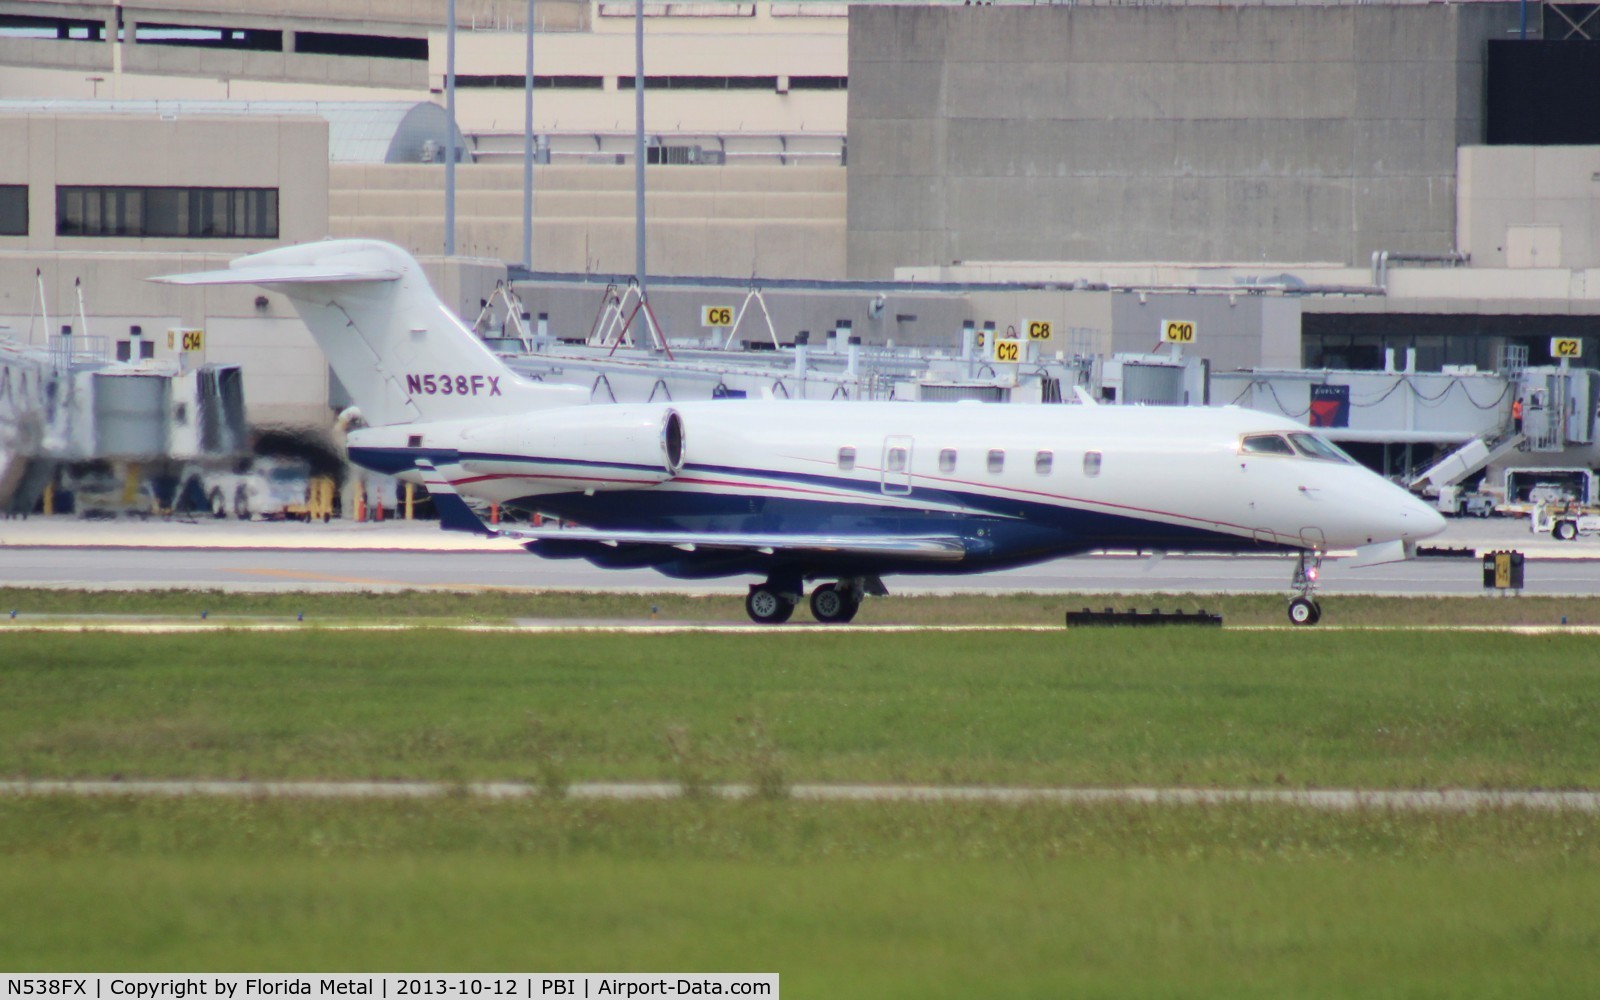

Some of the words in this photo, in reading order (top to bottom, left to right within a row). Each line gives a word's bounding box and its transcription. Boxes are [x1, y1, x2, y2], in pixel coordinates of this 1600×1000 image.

[709, 309, 731, 325] C6
[1030, 323, 1050, 339] C8
[1168, 323, 1192, 341] C10
[182, 332, 201, 350] C14
[1558, 341, 1577, 355] C2
[998, 343, 1018, 360] C12
[405, 373, 502, 397] N538FX
